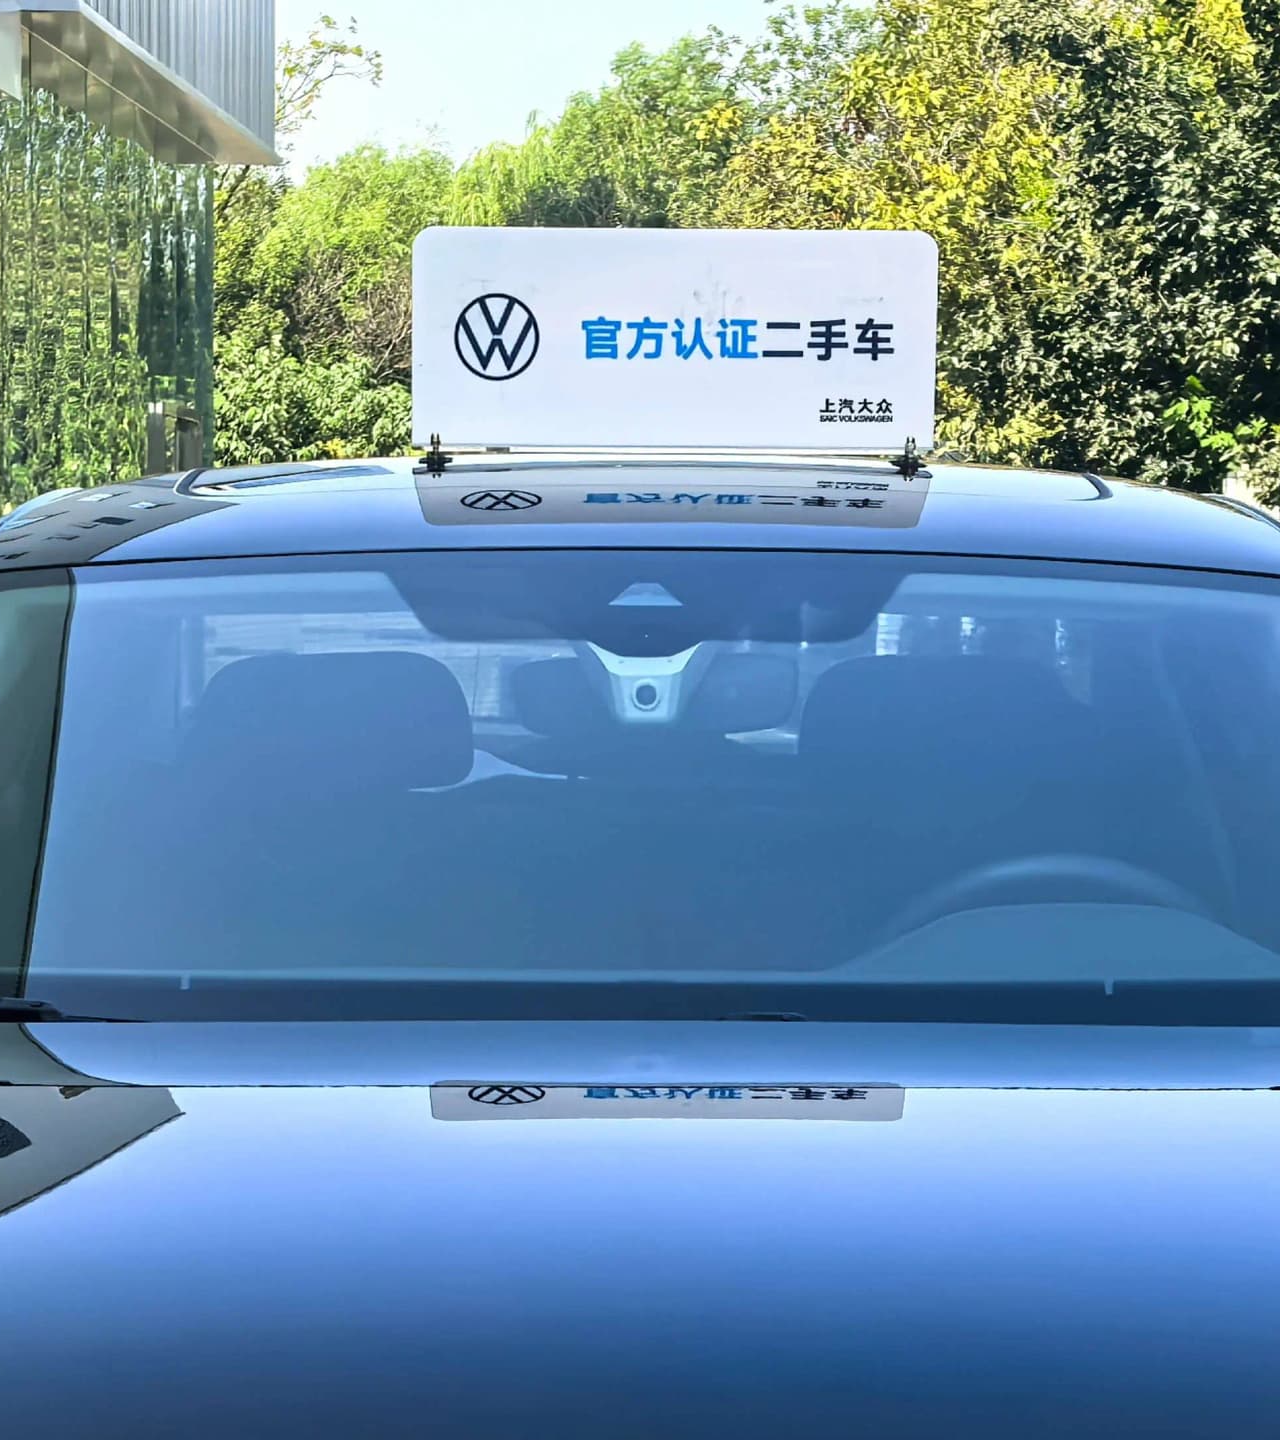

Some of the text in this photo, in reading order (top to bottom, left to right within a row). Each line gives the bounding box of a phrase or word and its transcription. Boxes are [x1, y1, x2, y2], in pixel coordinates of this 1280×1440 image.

[454, 293, 540, 381] VW
[581, 315, 895, 362] 官方认证二手车
[819, 397, 893, 414] 上汽大众
[838, 414, 894, 423] VOLKSWAGEN
